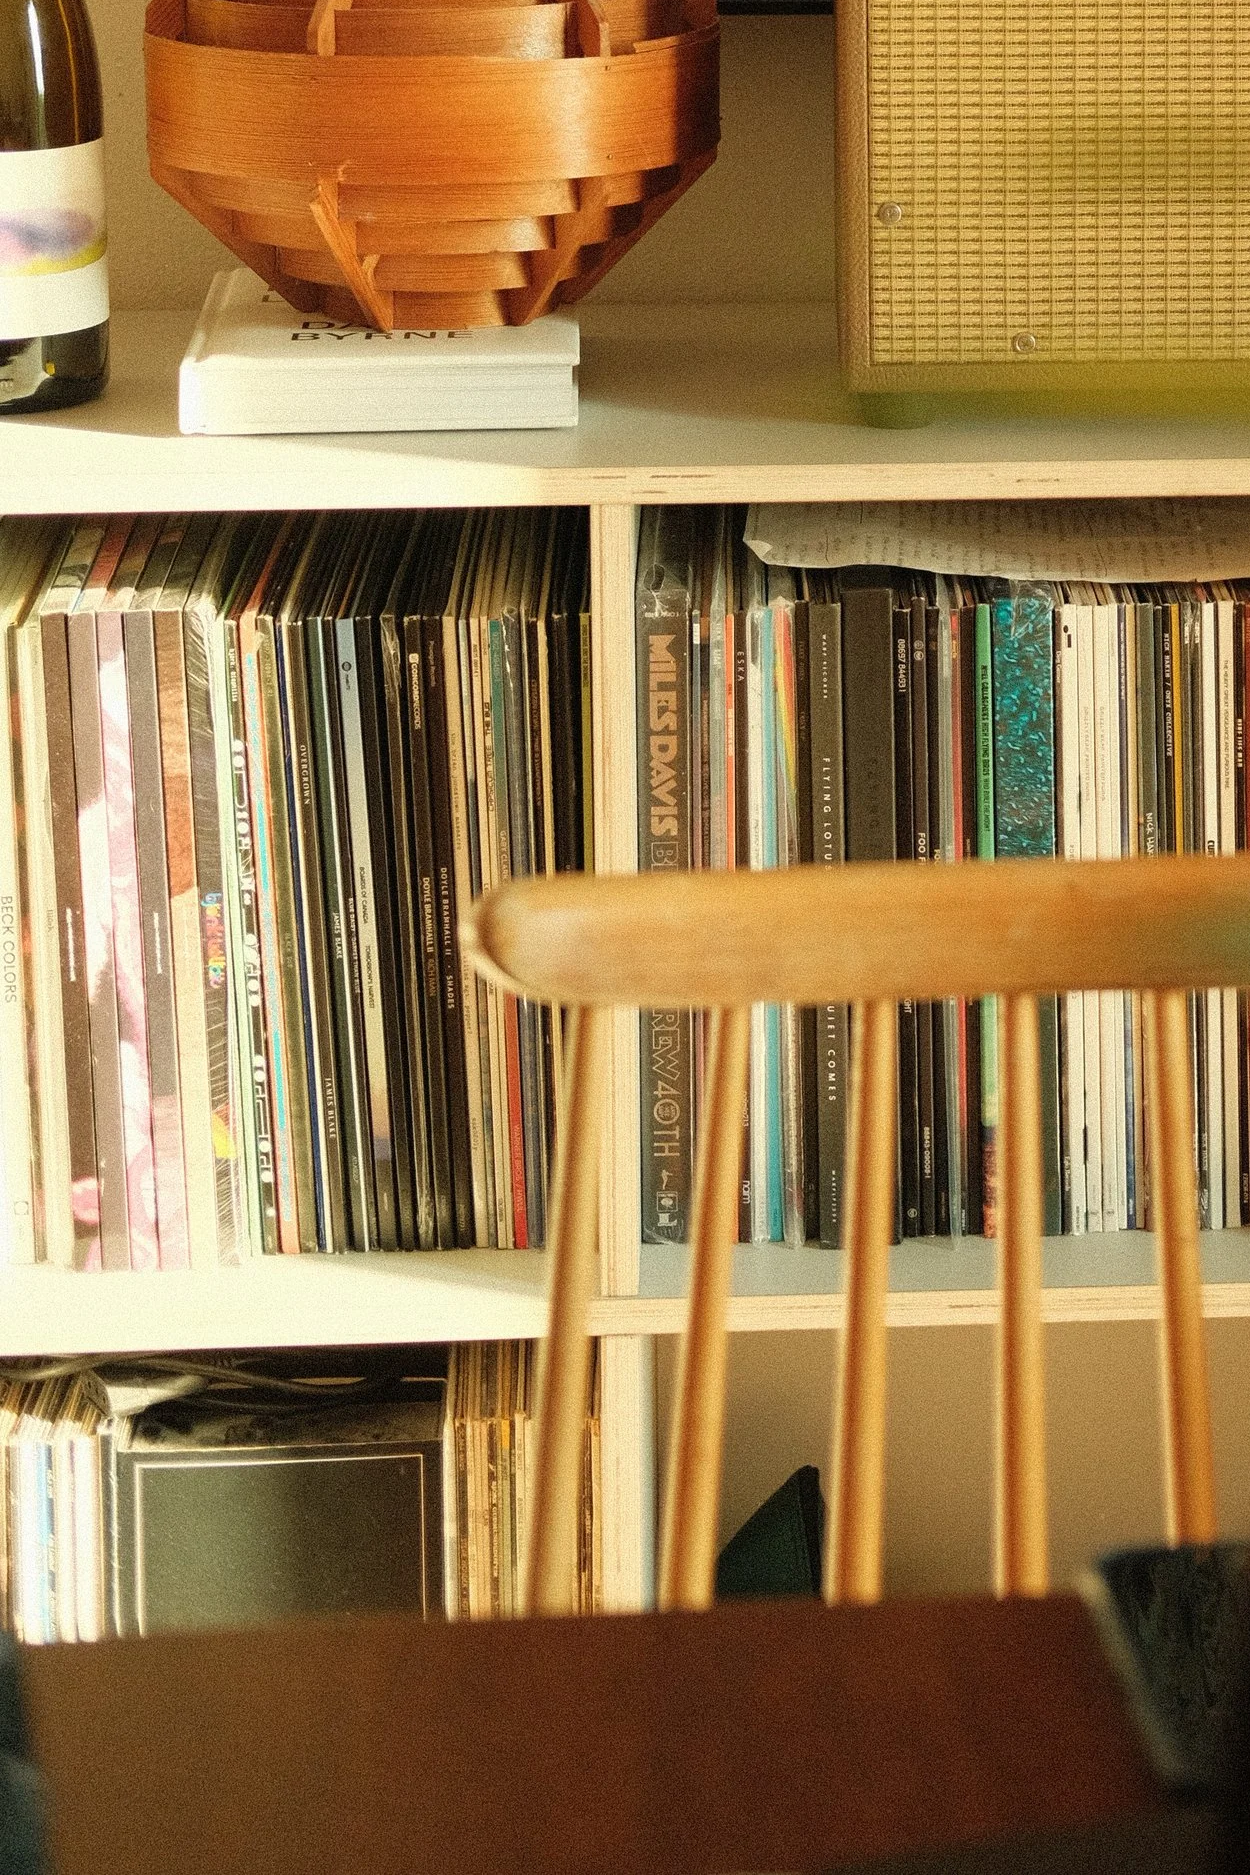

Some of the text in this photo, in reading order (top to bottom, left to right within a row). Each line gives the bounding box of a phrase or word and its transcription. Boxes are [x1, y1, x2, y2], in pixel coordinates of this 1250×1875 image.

[291, 330, 475, 341] BYRNE
[649, 634, 678, 731] MILES
[737, 651, 745, 682] ESKA
[649, 735, 679, 836] DAVIS
[823, 758, 832, 813] FLYING
[917, 832, 926, 853] FOO
[1145, 812, 1154, 835] NICK
[500, 830, 509, 879] GARY CLARK
[359, 866, 367, 890] BOARDS
[360, 891, 367, 899] OF
[422, 877, 432, 901] DOYLE
[440, 868, 449, 896] DOYLE
[300, 744, 336, 1139] OVERGROWN JAMES BLAKE
[333, 912, 344, 959] JAMES BLAKE
[424, 903, 434, 944] BRAMHALL
[442, 899, 452, 945] BRAMHALL
[1, 895, 18, 1004] BECK COLORS
[446, 975, 455, 1009] SHADES
[651, 1009, 681, 1081] REW
[826, 1004, 837, 1102] UIET COMES
[742, 1180, 751, 1204] naim
